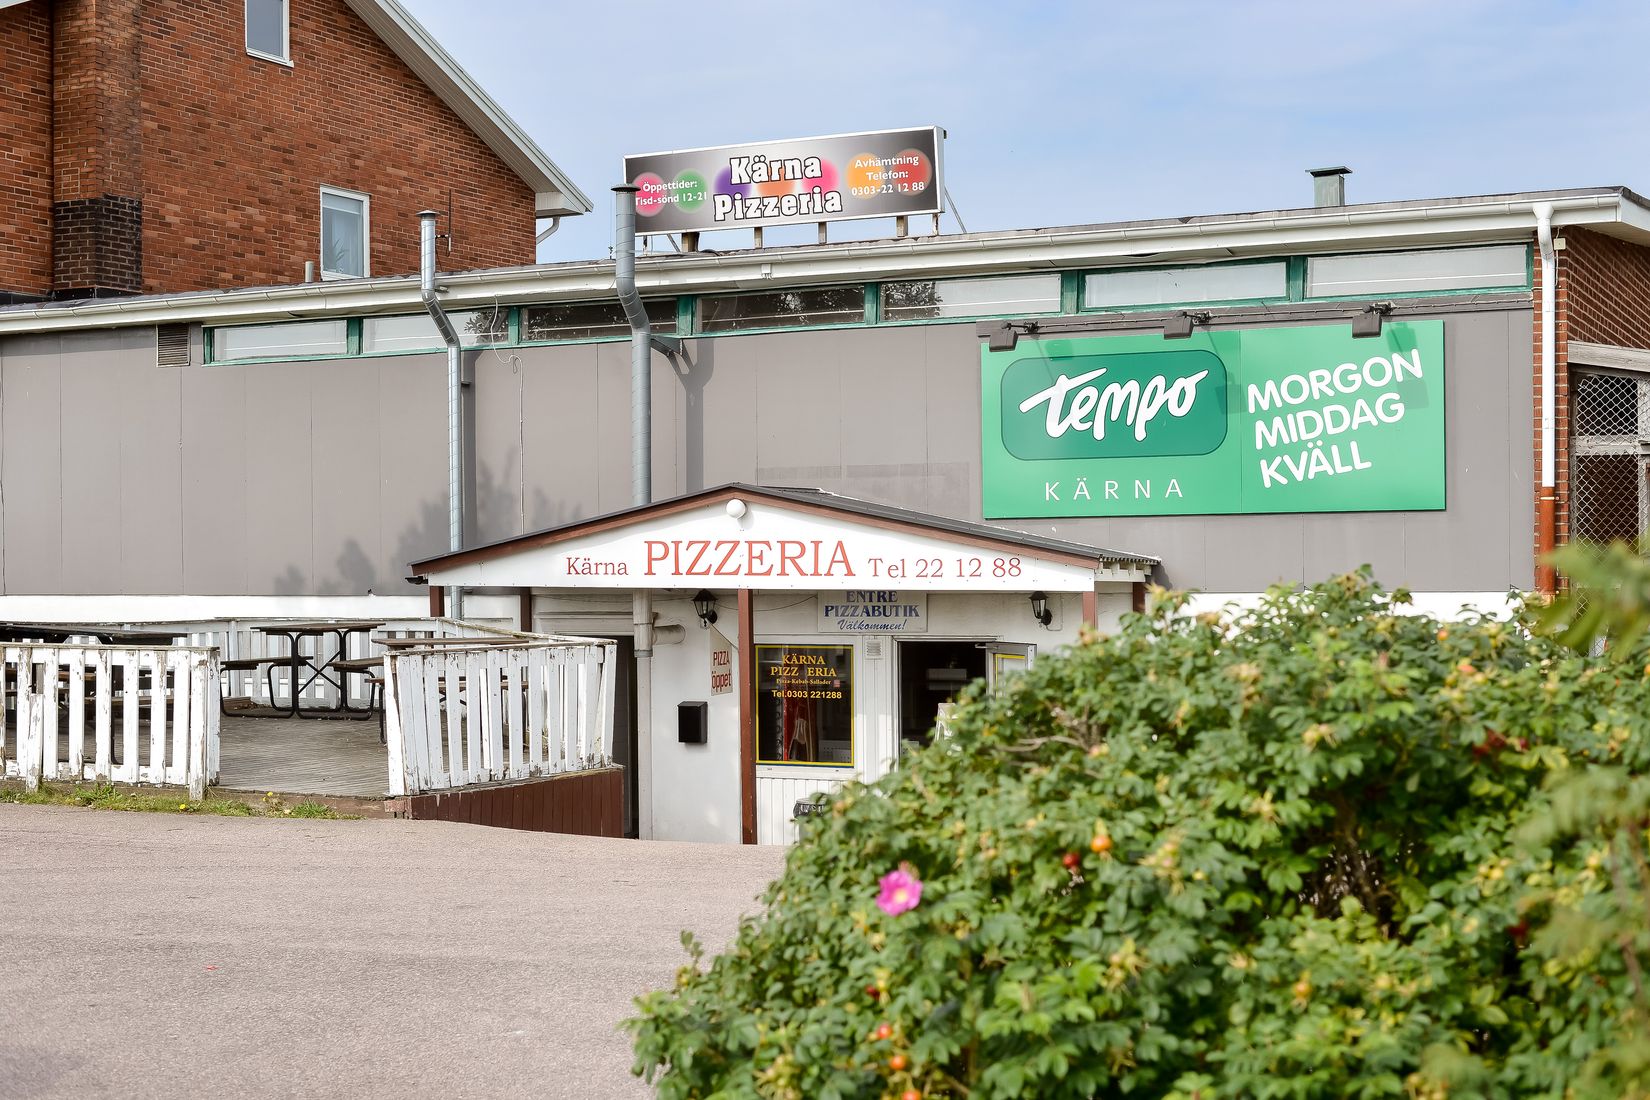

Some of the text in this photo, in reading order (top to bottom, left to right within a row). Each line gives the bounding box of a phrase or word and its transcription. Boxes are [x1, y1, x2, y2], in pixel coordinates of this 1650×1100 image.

[855, 156, 919, 168] Avhämtning
[729, 154, 822, 186] Kärna
[866, 171, 909, 181] Telefon:
[642, 181, 698, 193] Öppettider:
[851, 181, 925, 196] 0303-22 12 88
[682, 191, 707, 202] 12-21
[712, 185, 843, 222] Pizzeria
[1246, 349, 1423, 413] MORGON
[1019, 367, 1209, 441] tempo
[1254, 393, 1405, 450] MIDDAG
[1259, 440, 1372, 488] KVÄLL
[1045, 477, 1183, 501] KÄRNA
[565, 540, 1022, 578] Kärna PIZZERIA Tel 22 12 88
[846, 590, 898, 602] ENTRE
[824, 605, 920, 617] PIZZABUTIK
[837, 619, 907, 630] Välkommen!
[713, 651, 730, 666] PIZZA
[782, 653, 825, 665] KÄRNA
[711, 669, 731, 692] öppet
[771, 690, 842, 699] Tel.0303 221288
